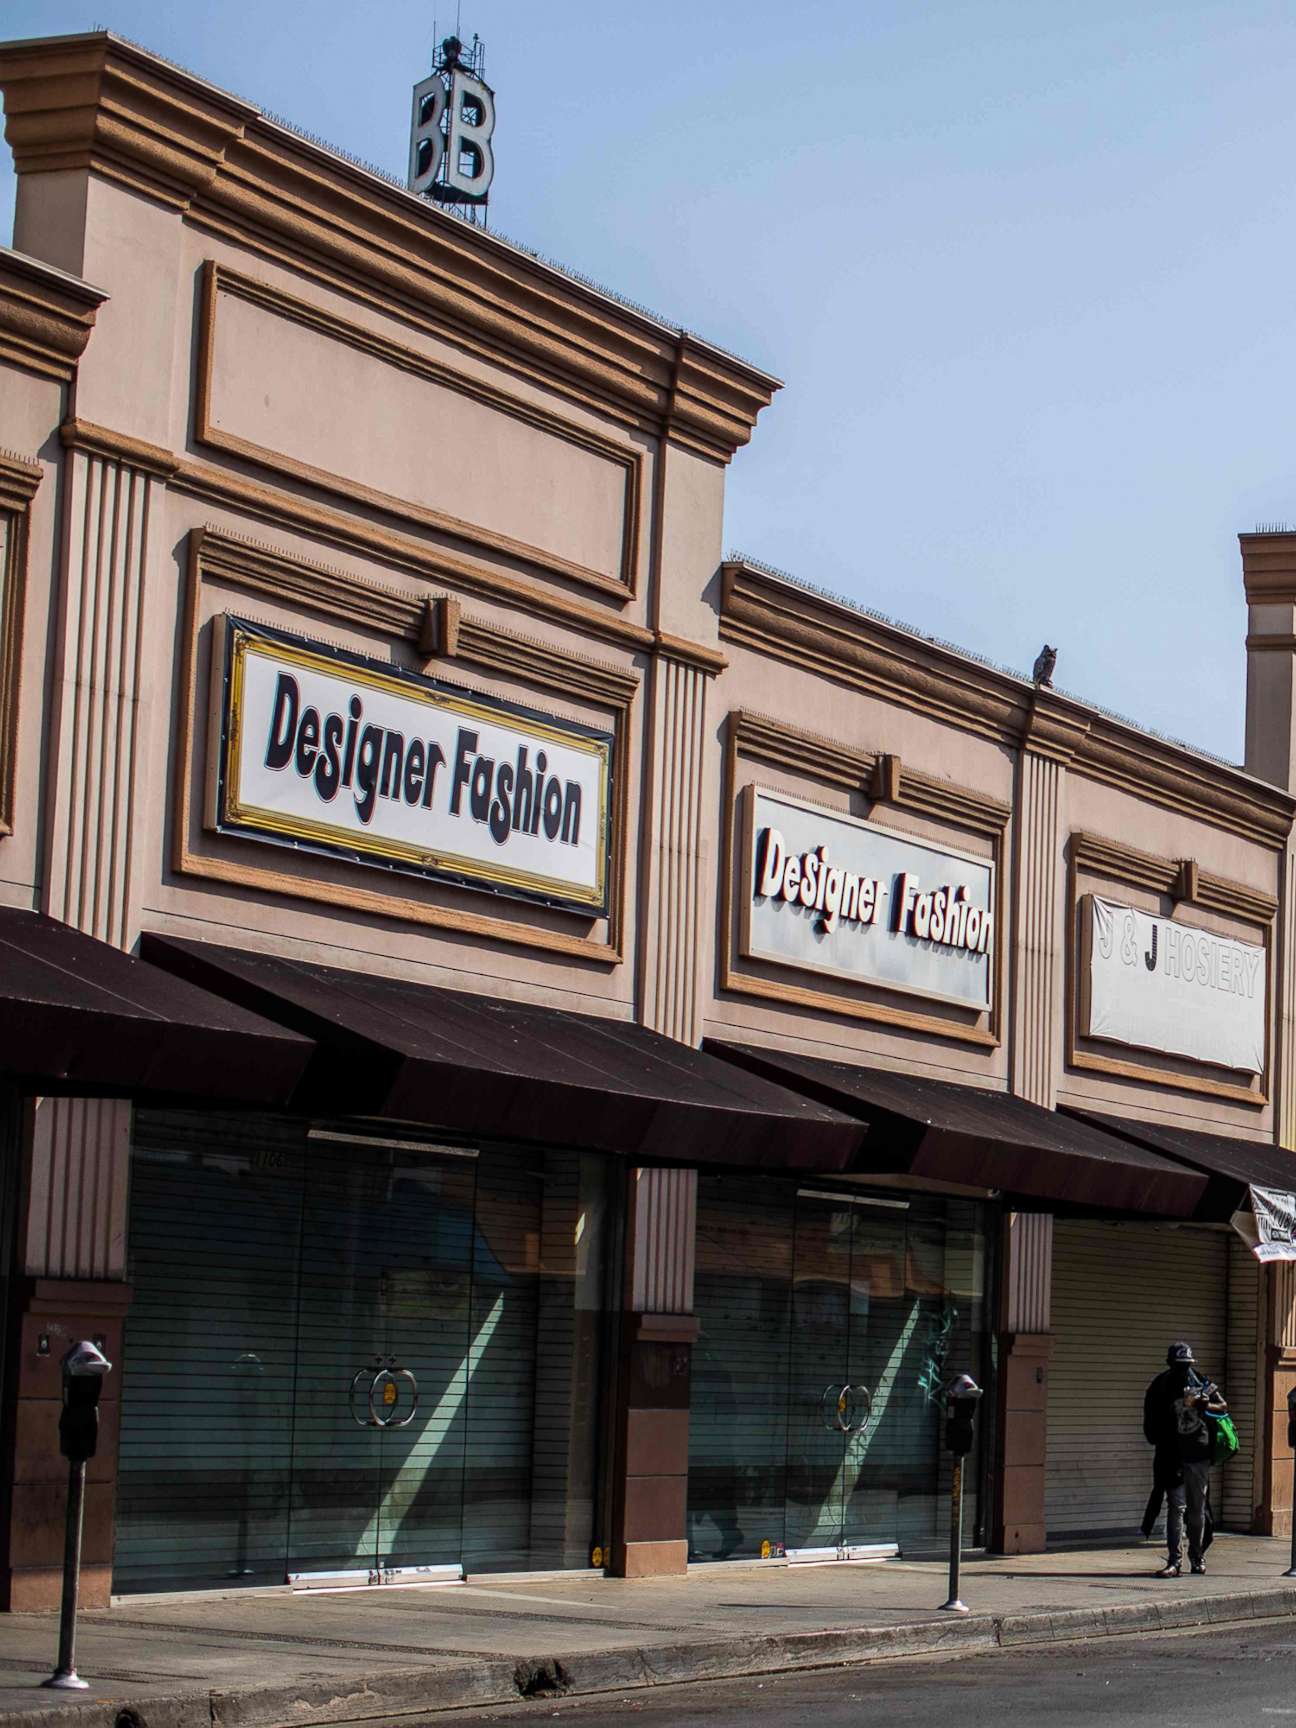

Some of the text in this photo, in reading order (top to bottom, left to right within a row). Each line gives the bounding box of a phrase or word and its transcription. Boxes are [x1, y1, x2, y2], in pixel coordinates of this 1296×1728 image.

[264, 670, 582, 846] Designer Fashion
[758, 827, 993, 954] Designer Fashion
[1120, 914, 1137, 967] &
[1144, 924, 1157, 972] J
[1164, 926, 1259, 999] HOSIERY
